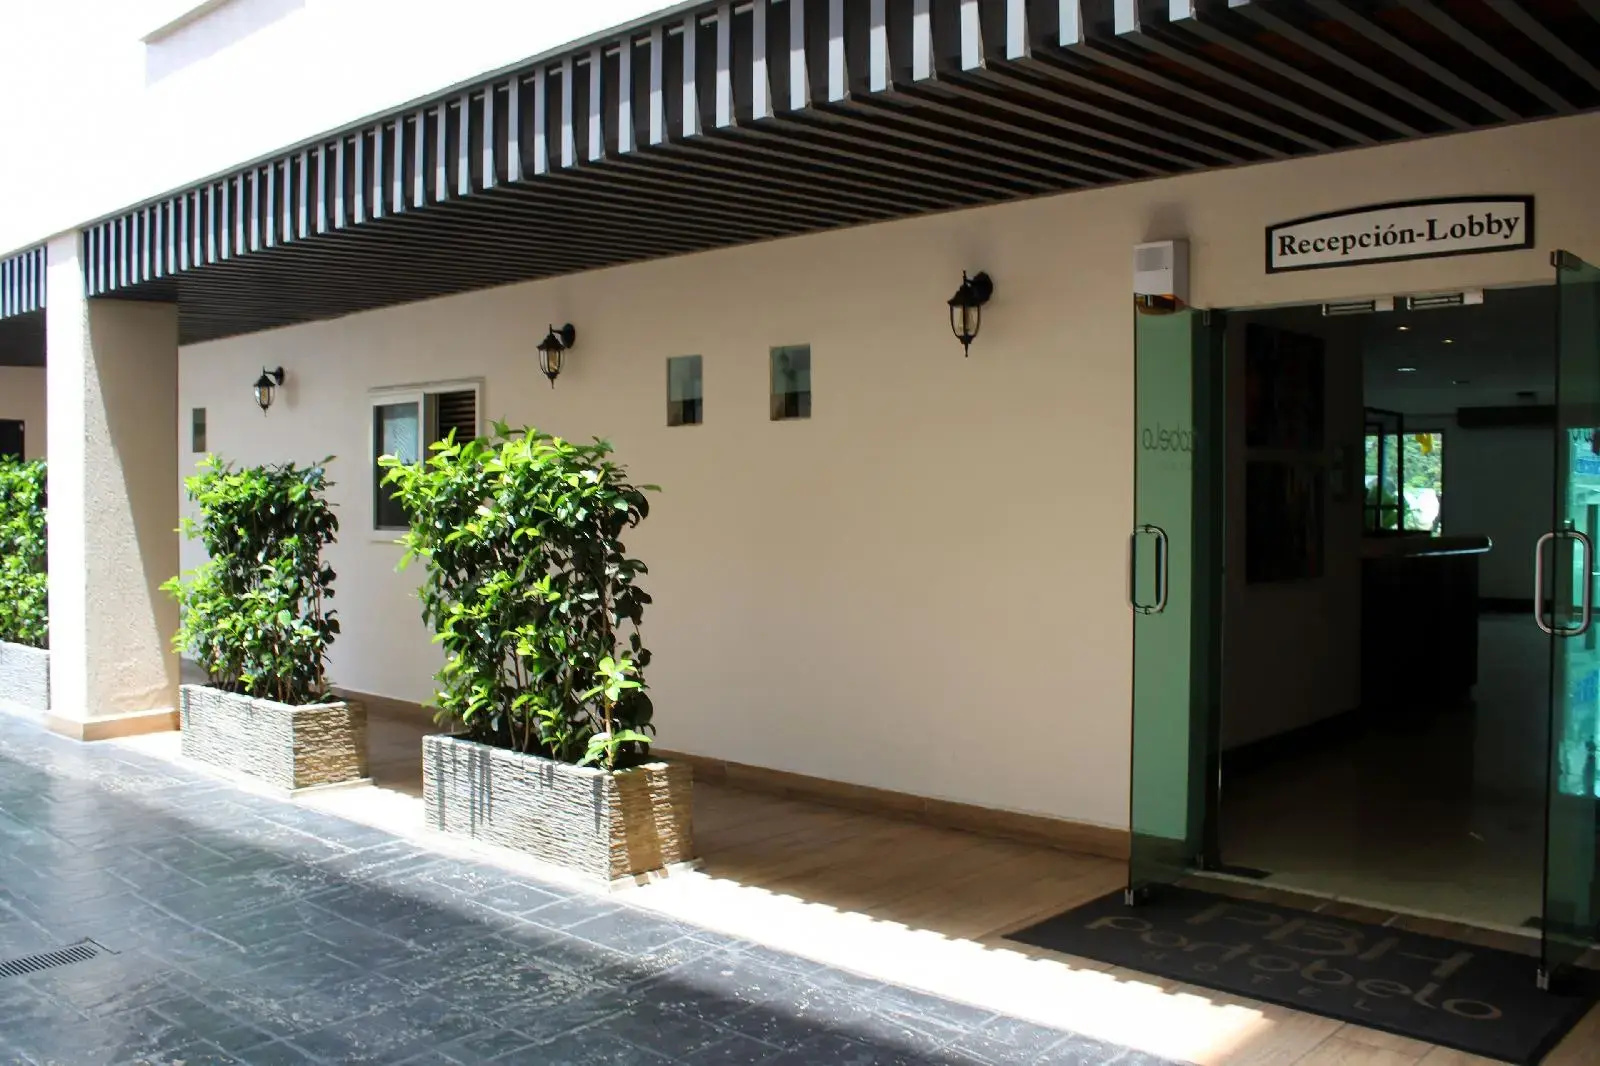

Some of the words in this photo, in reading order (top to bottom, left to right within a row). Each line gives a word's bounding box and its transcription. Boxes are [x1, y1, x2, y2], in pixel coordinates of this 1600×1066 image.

[1278, 212, 1521, 257] Recepción-Lobby
[1083, 916, 1503, 1020] Portobelo
[1185, 903, 1474, 979] PBH
